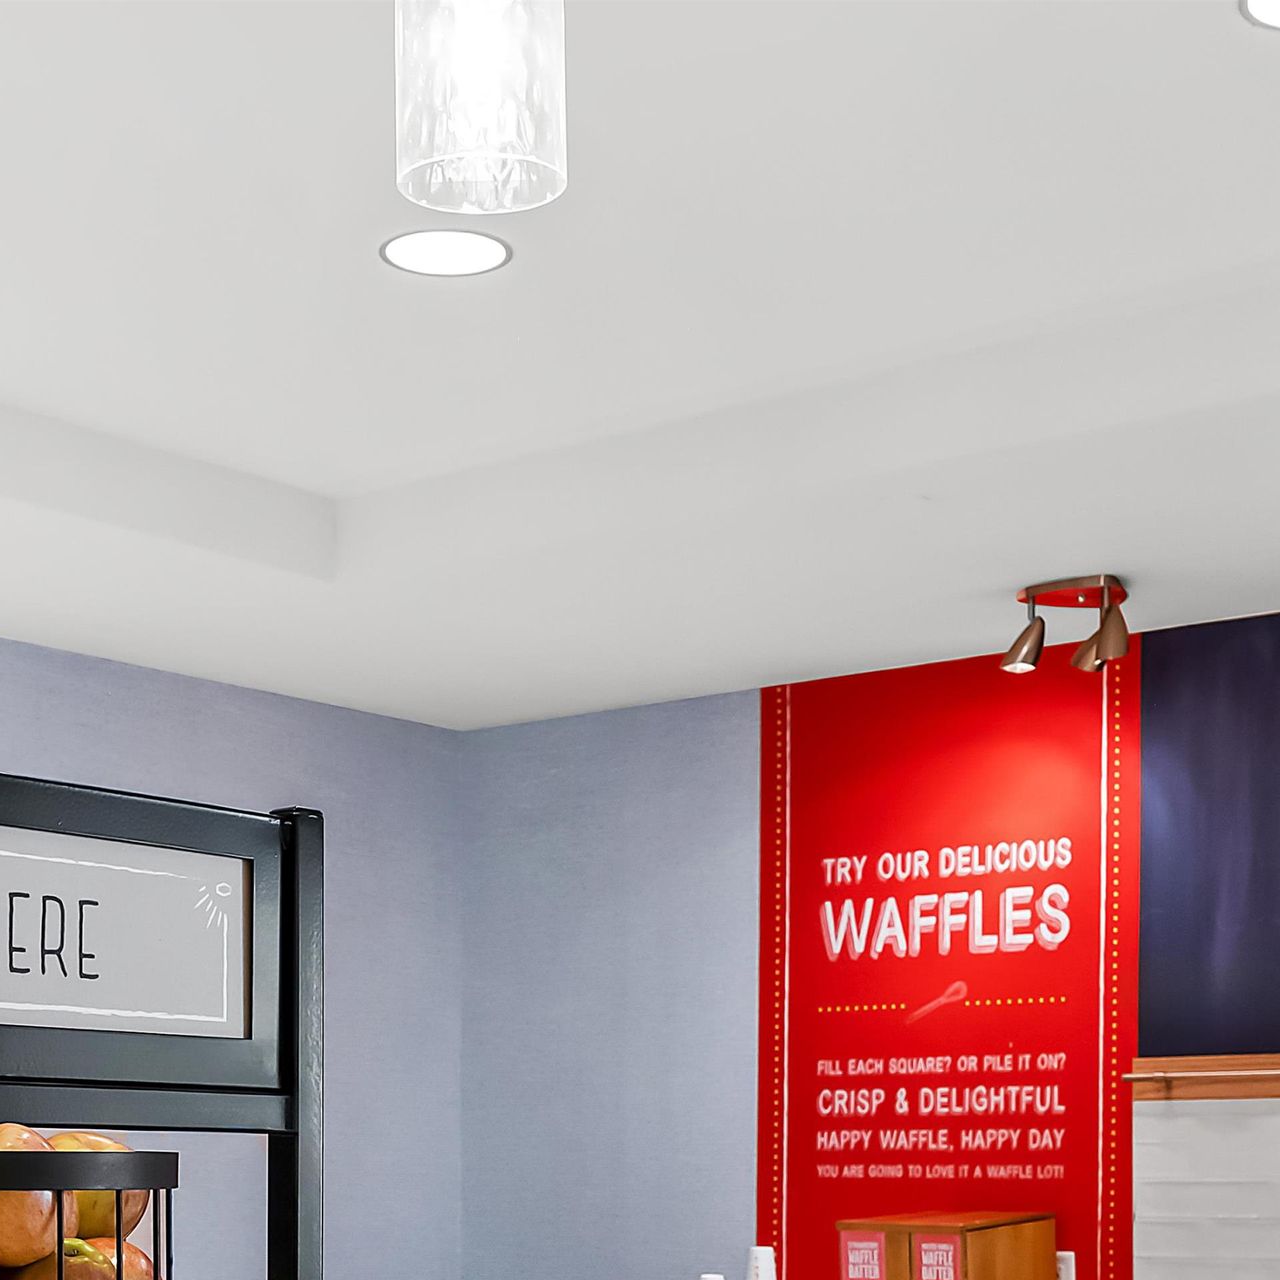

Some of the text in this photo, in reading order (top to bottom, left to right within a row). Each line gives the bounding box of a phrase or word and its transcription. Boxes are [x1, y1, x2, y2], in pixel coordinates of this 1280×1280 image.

[823, 837, 1072, 884] TRY OUR DELICIOUS
[821, 884, 1070, 961] WAFFLES
[817, 1052, 1067, 1076] FILL EACH SQUARE? OR PILE IT ON?
[818, 1084, 1066, 1116] CRISP & DELIGHTFUL
[817, 1128, 1065, 1152] HAPPY WAFFLE, HAPPY DAY
[817, 1165, 1065, 1179] YOU ARE GOING TO LOVE IT A WAFFLE LOT!
[848, 1249, 878, 1264] WAFFLE
[922, 1250, 953, 1266] WAFFLE
